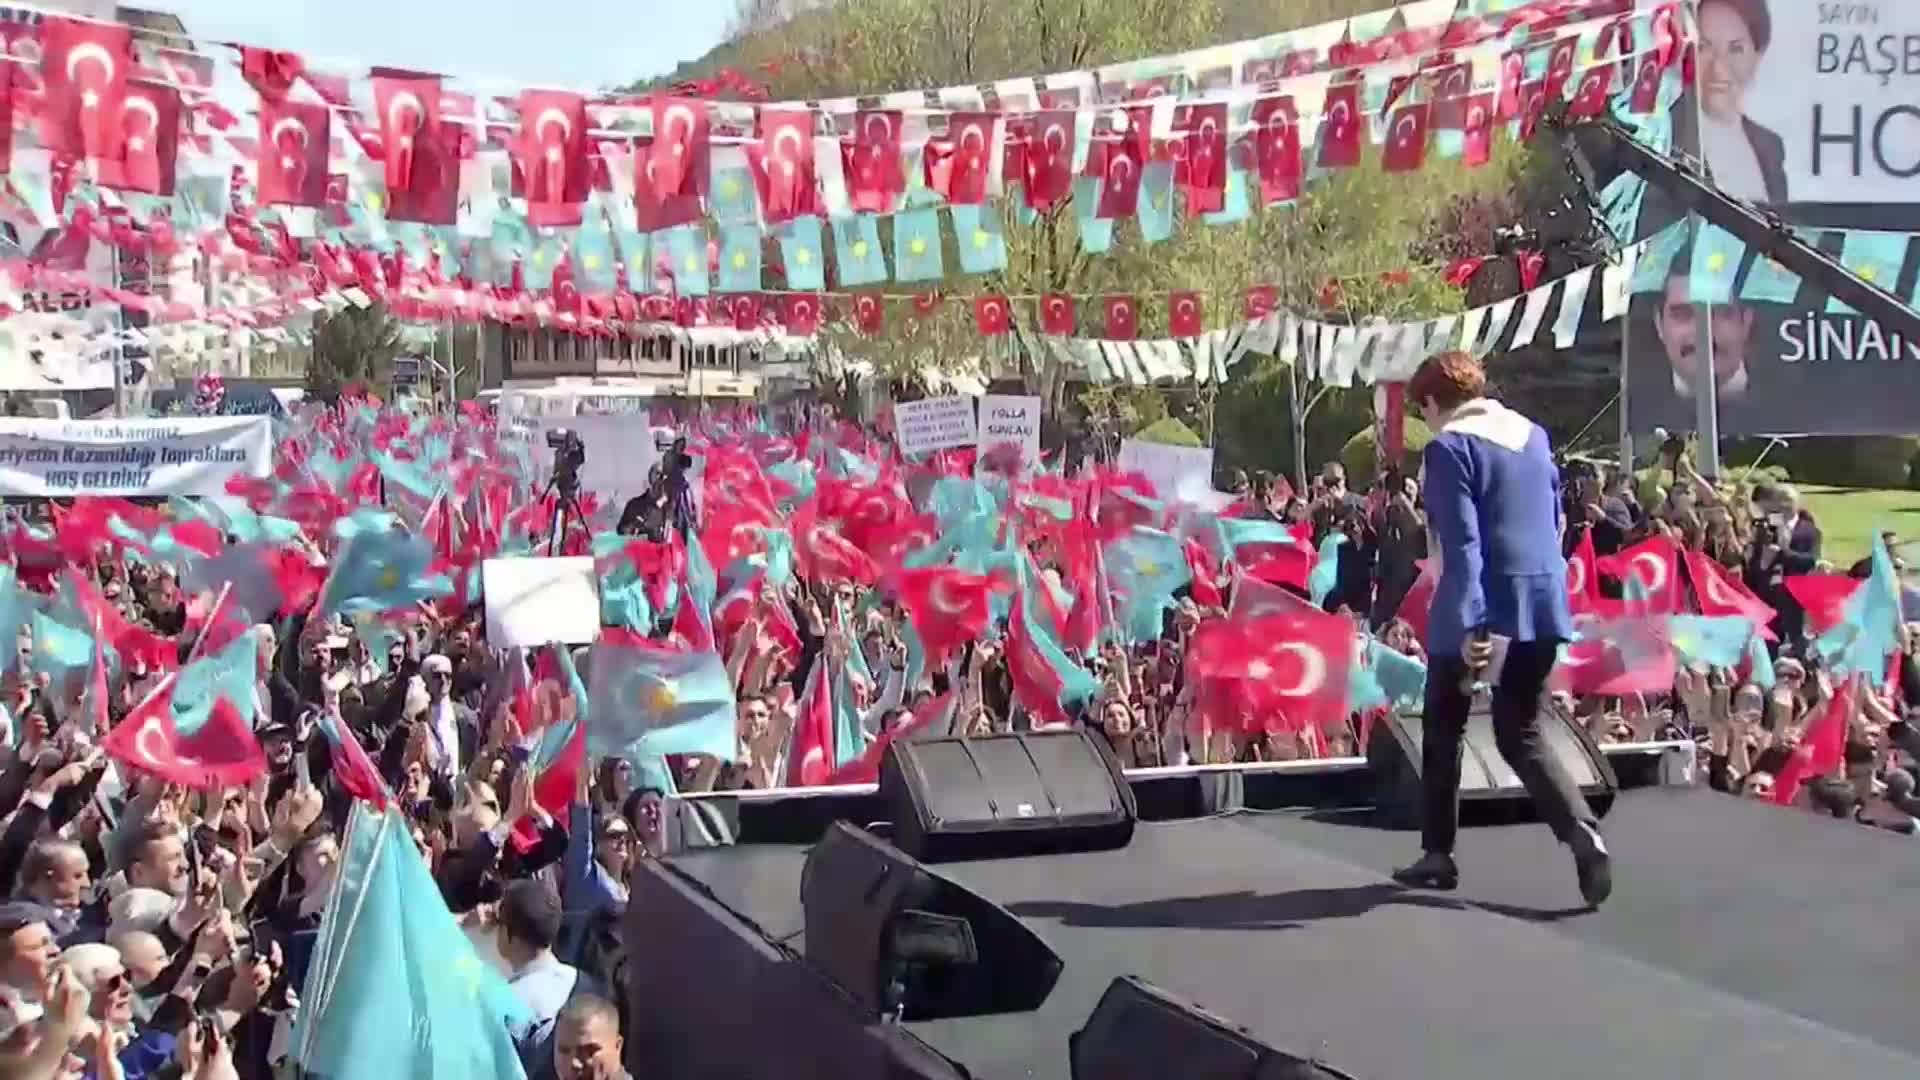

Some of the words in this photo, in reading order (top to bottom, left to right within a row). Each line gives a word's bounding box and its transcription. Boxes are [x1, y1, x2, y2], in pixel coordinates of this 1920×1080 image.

[1817, 3, 1878, 24] SAYIN
[45, 470, 79, 490] HOŞ
[82, 466, 154, 489] GELDİNİZ
